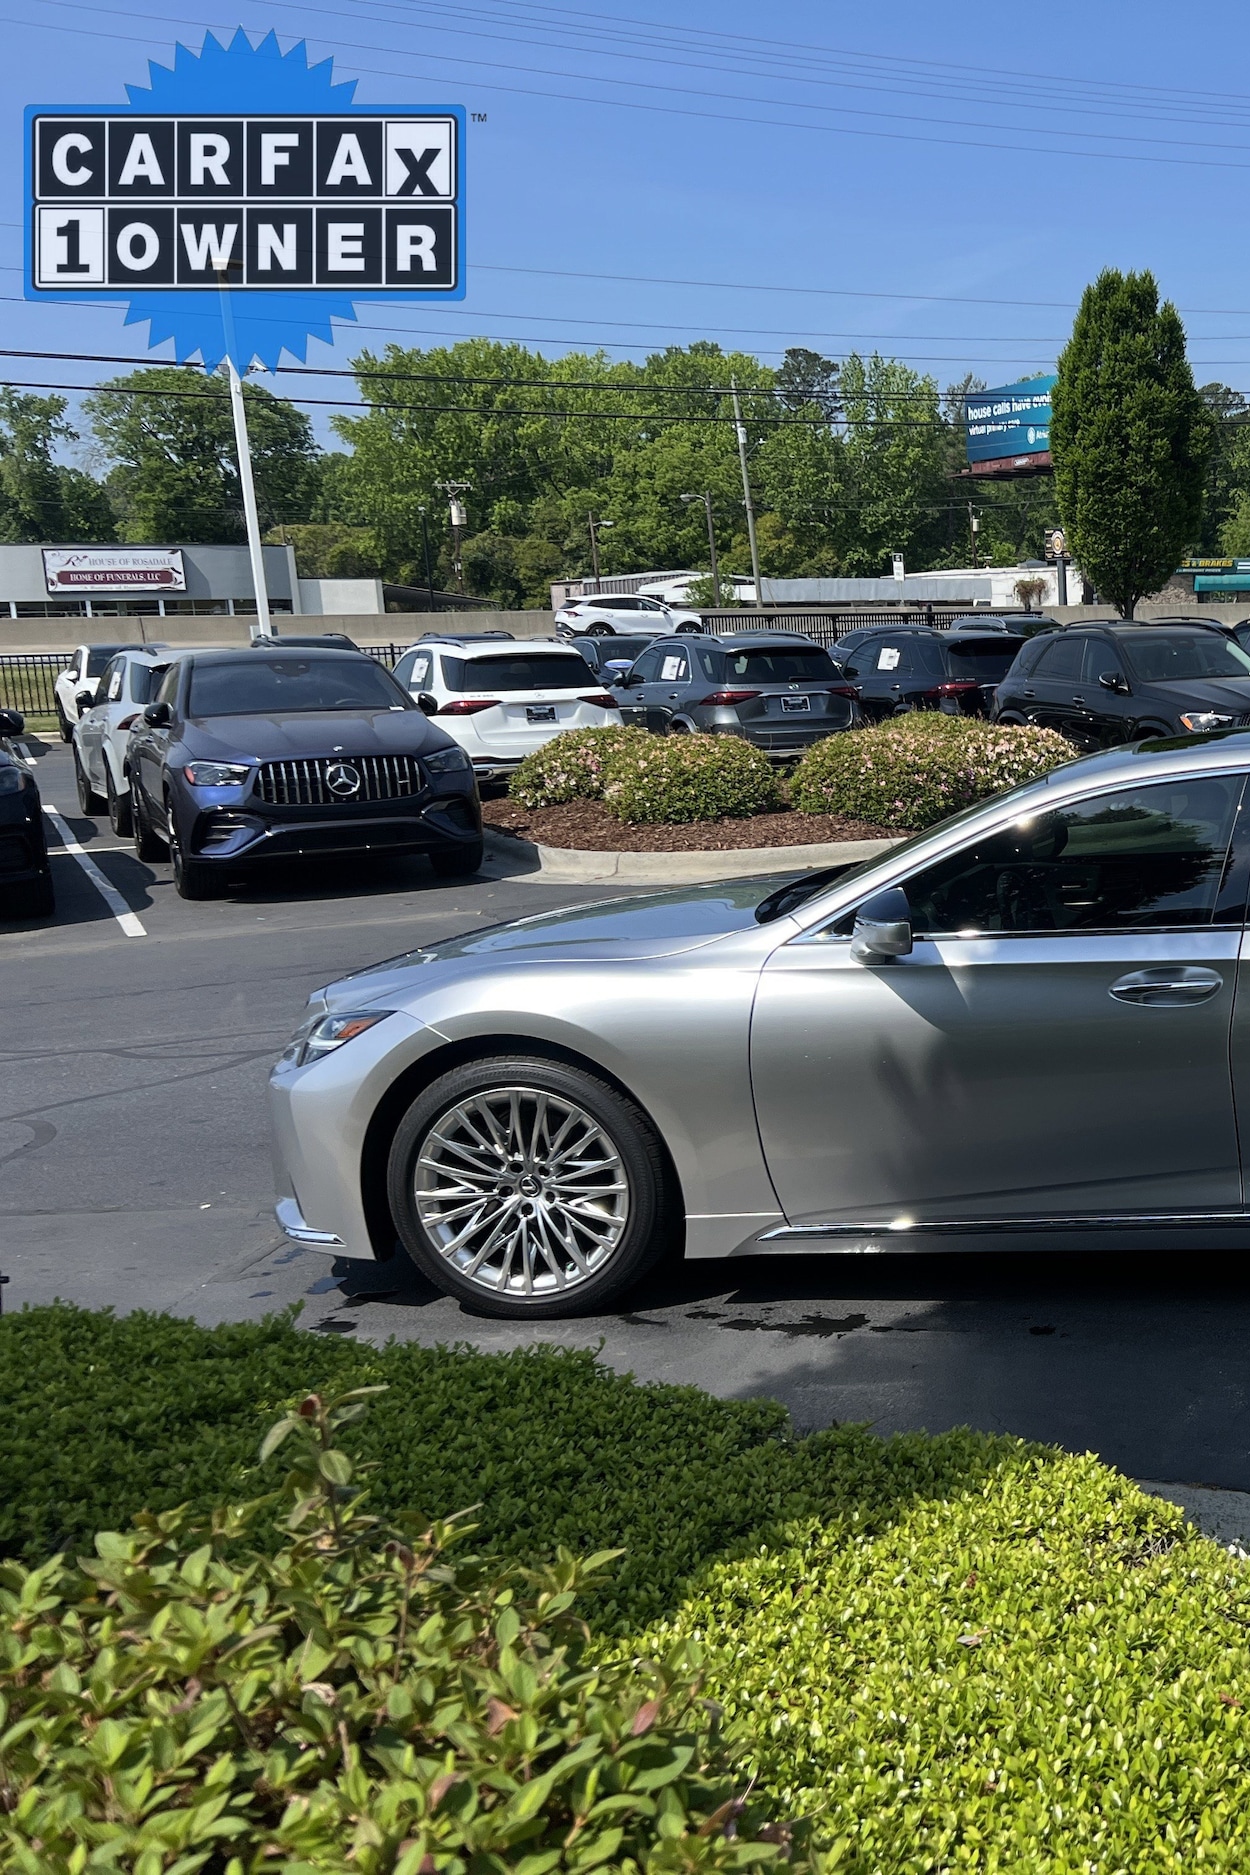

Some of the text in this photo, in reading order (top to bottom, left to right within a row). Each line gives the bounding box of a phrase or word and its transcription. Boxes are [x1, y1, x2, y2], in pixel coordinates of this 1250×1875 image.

[968, 391, 1052, 420] house calls have evol
[969, 425, 986, 436] virtual
[987, 421, 1007, 436] primary
[89, 558, 117, 566] HOUSE
[118, 558, 130, 566] OF
[132, 558, 173, 566] ROSADALE
[70, 573, 93, 581] HOME
[93, 573, 106, 581] OF
[147, 573, 161, 581] LLC
